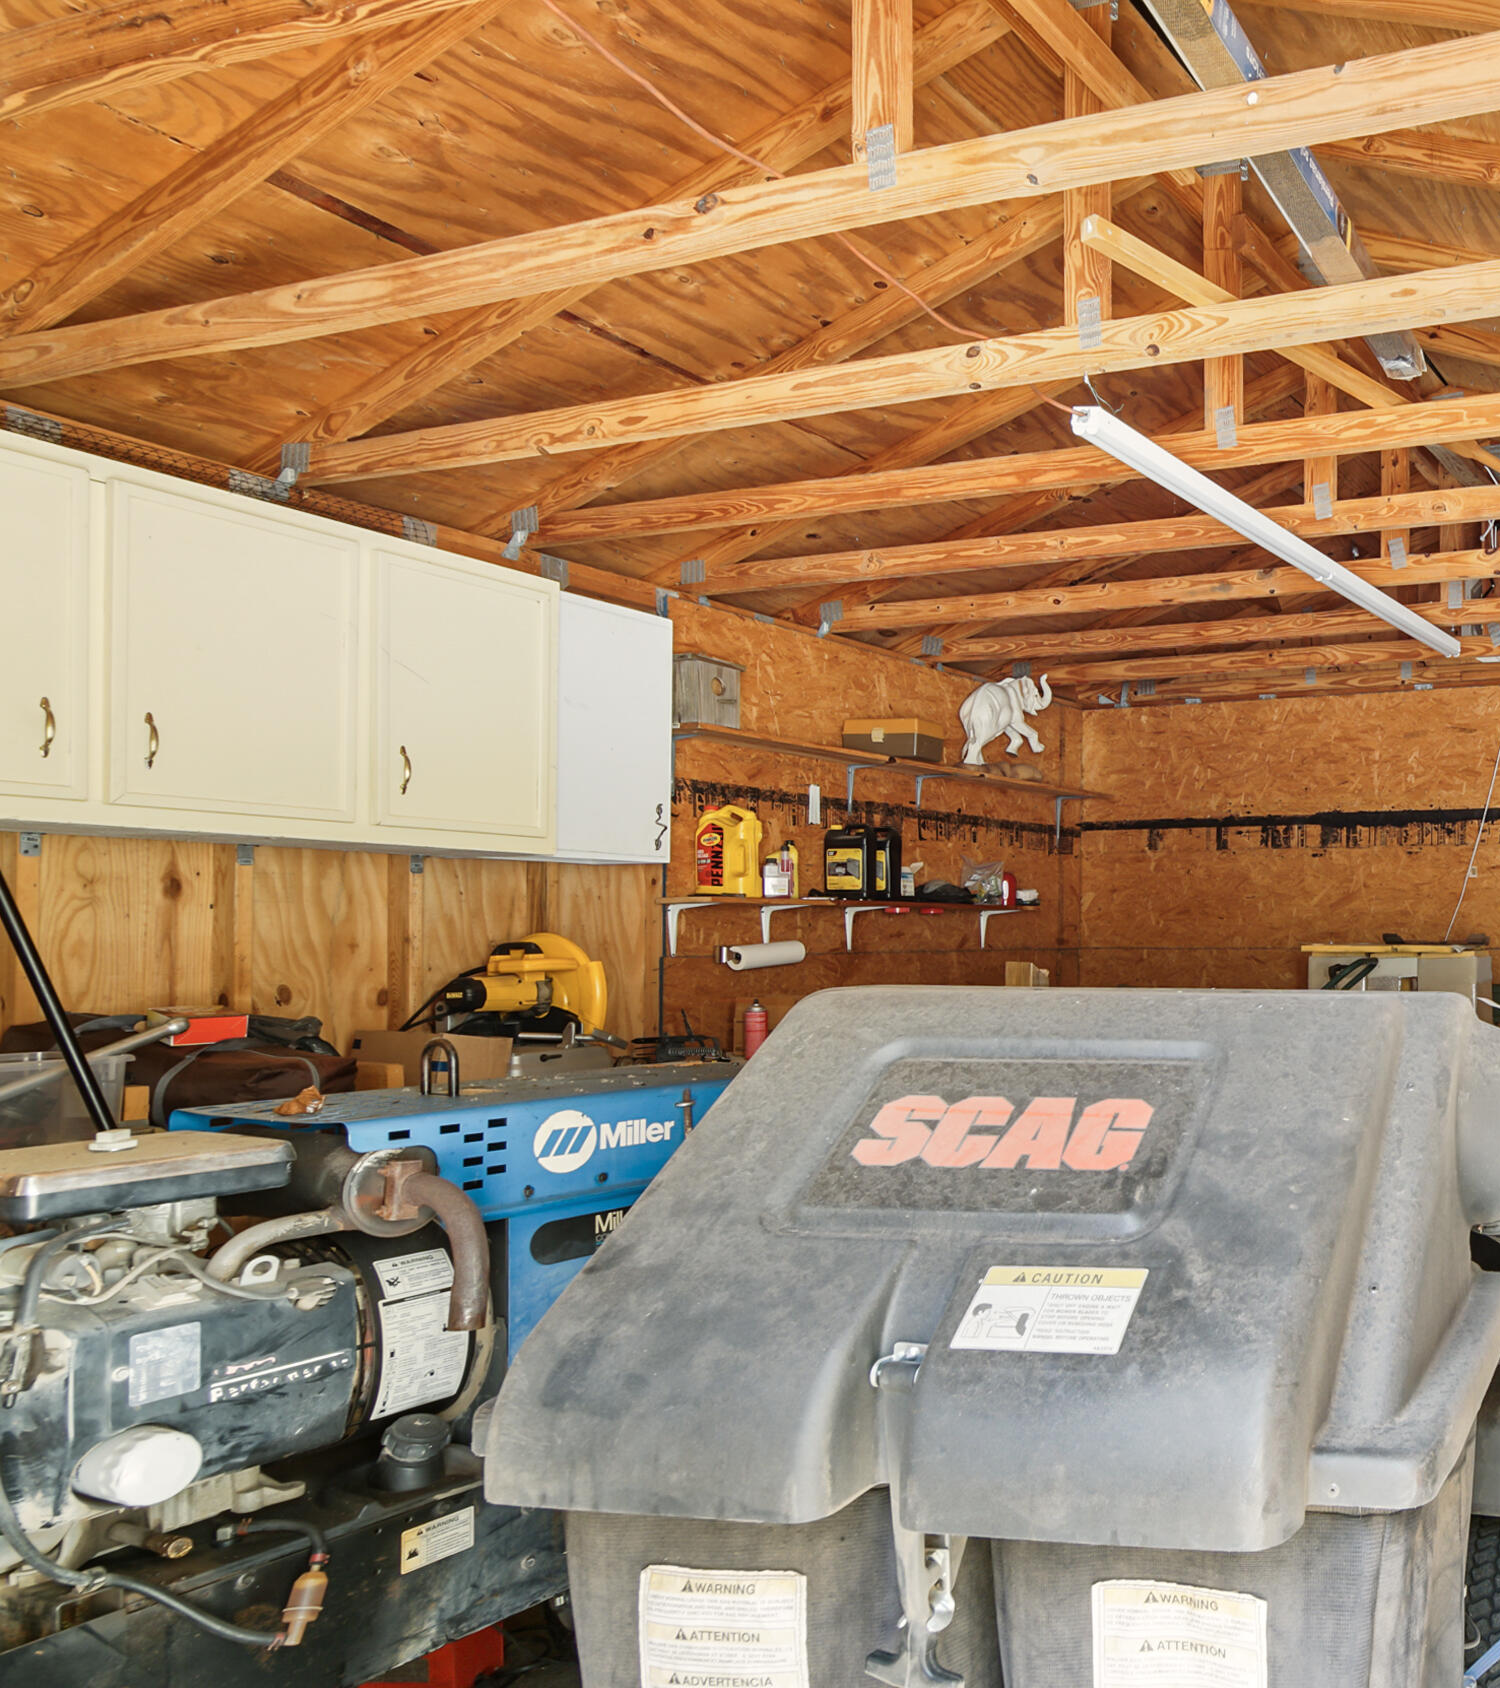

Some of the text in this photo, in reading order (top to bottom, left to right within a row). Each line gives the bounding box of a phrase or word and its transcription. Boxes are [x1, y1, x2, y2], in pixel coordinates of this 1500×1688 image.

[600, 1118, 675, 1150] Miller
[850, 1095, 1155, 1171] SCAG
[1031, 1272, 1104, 1284] CAUTION
[1051, 1293, 1132, 1303] THROWN OBJECTS
[695, 1583, 756, 1595] WARNING
[1160, 1594, 1219, 1612] WARNING
[690, 1630, 760, 1643] ATTENTION
[1157, 1640, 1226, 1659] ATTENTION
[682, 1675, 773, 1688] ADVERTENCIA
